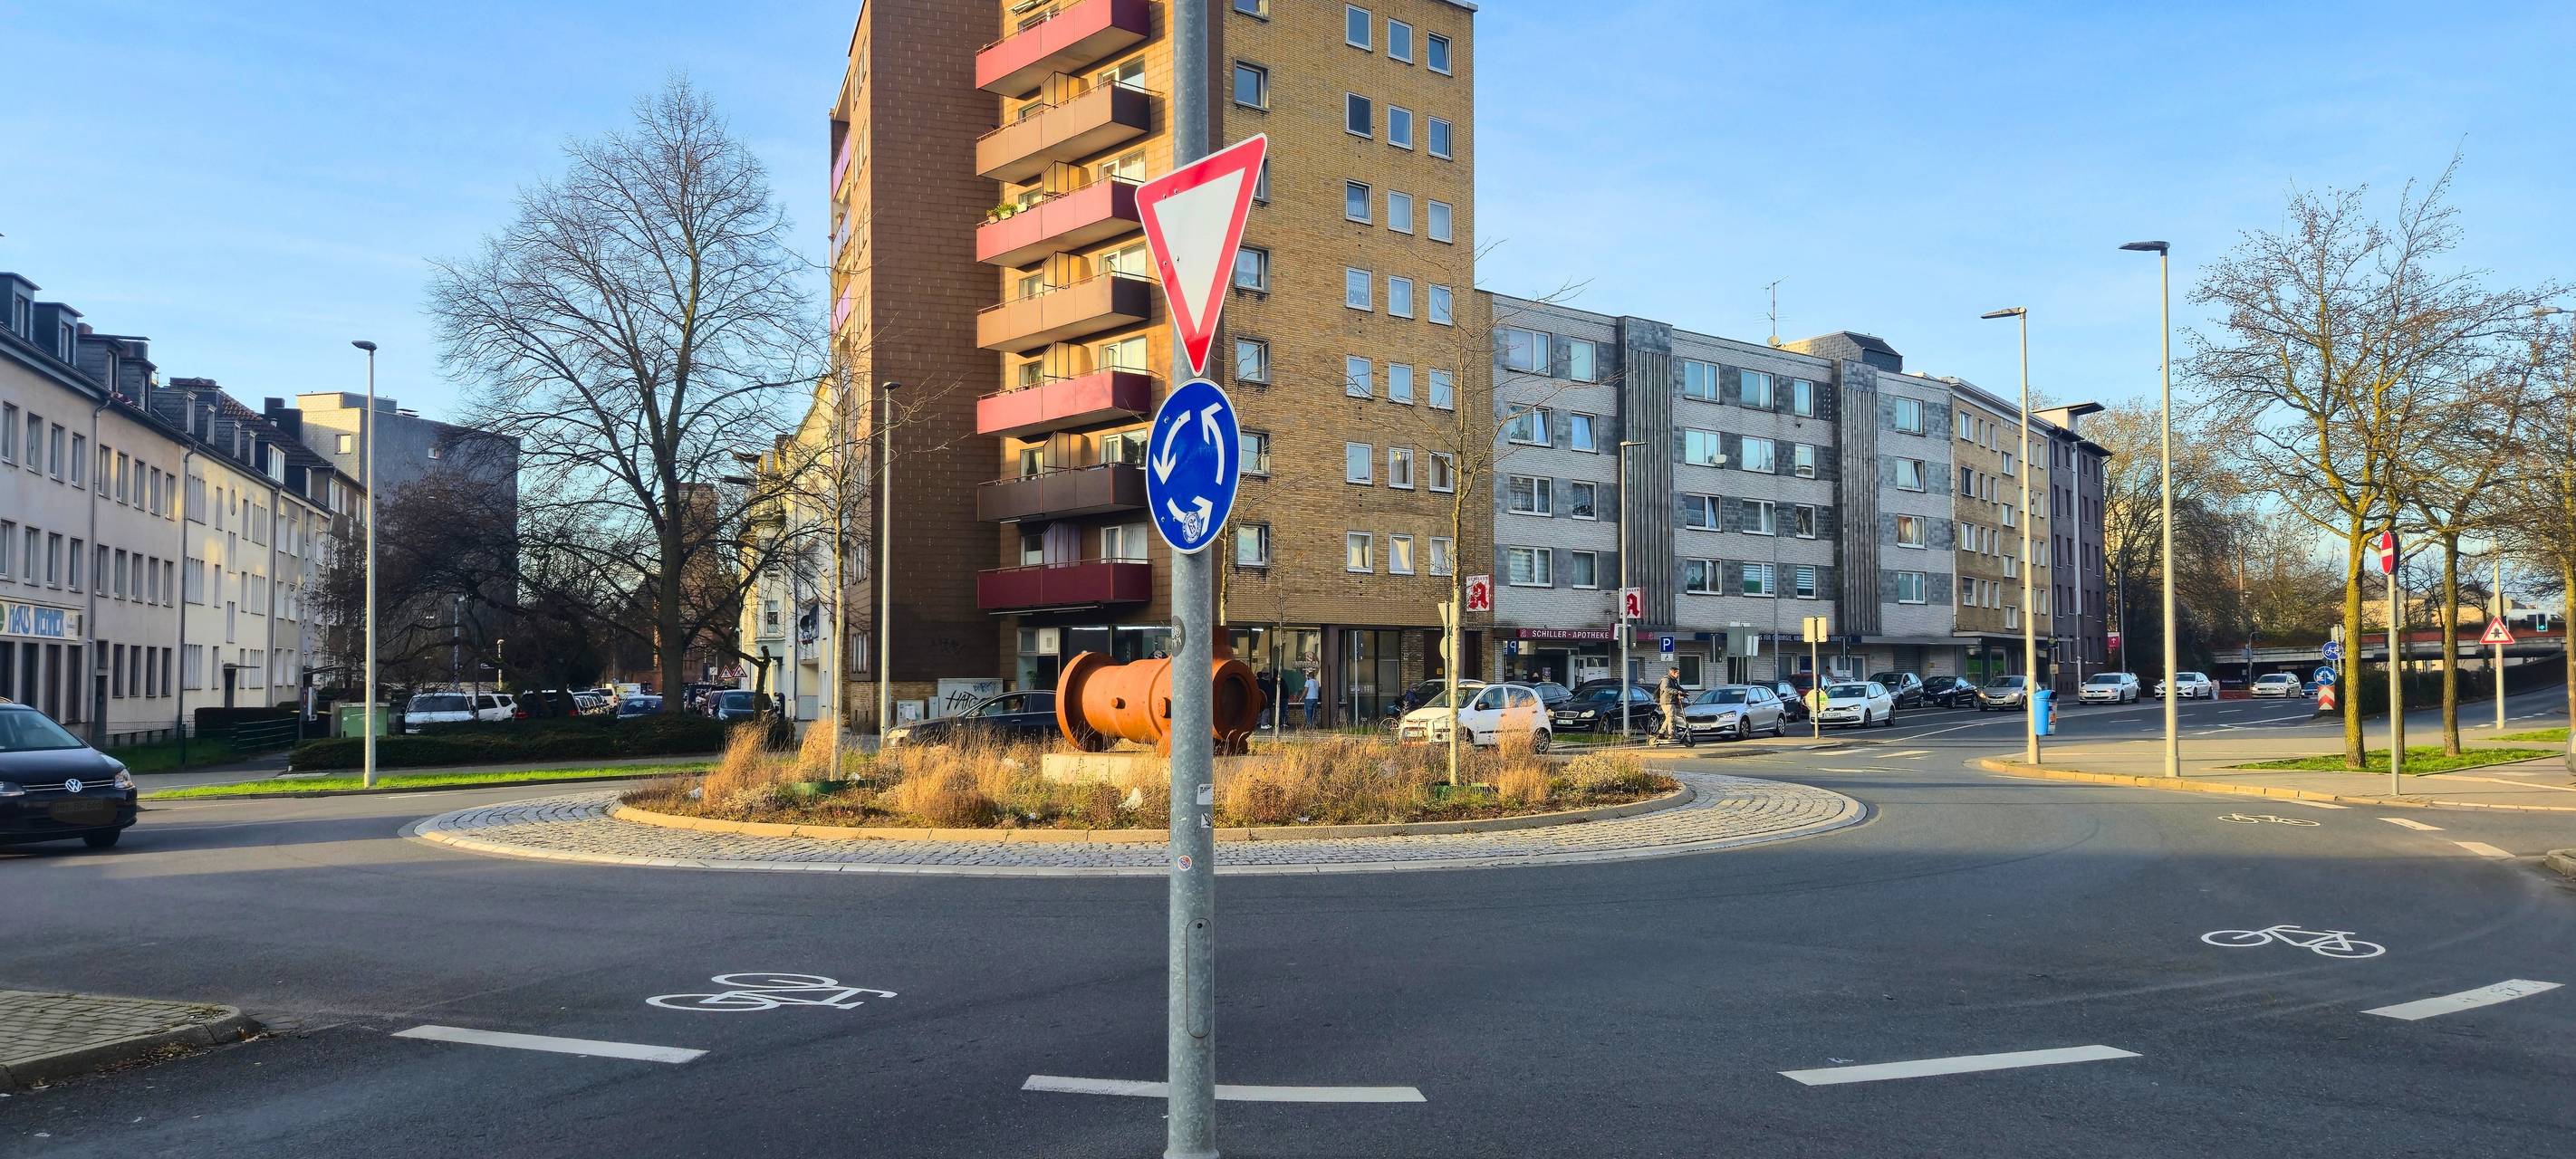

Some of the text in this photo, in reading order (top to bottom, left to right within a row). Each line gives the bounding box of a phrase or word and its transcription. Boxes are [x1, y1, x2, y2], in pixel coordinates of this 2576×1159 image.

[8, 604, 31, 635] HAUS
[1532, 629, 1567, 638] SCHILLER
[1572, 631, 1610, 639] APOTHEKE
[1663, 638, 1671, 651] P
